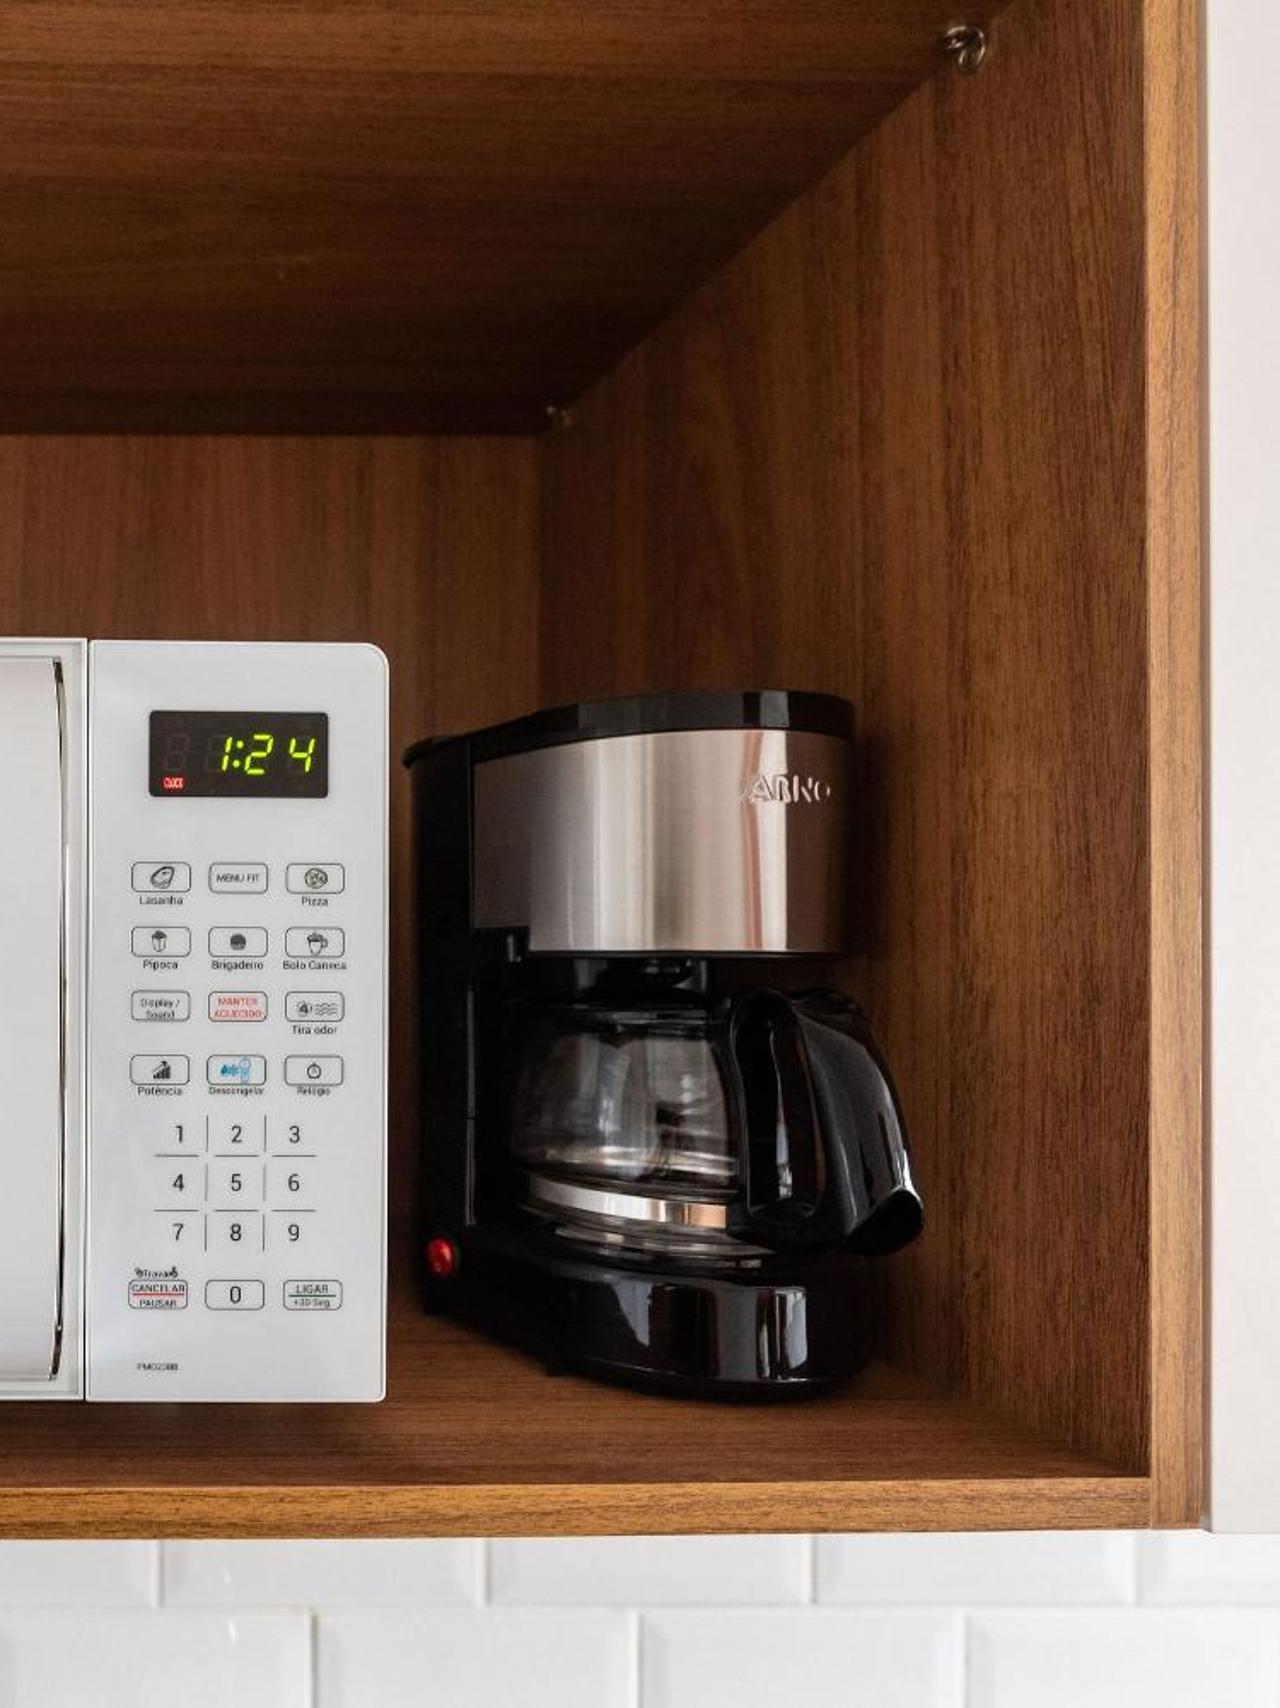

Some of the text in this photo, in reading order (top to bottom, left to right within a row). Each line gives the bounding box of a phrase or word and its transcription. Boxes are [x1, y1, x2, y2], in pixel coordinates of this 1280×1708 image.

[221, 734, 315, 775] 1:24
[216, 873, 259, 882] MENU FIT
[140, 896, 183, 905] Lasanha
[302, 896, 328, 906] Pizza
[143, 960, 178, 970] Pipoca
[211, 960, 263, 972] Brigadeiro
[283, 960, 306, 970] Bolo
[292, 1025, 337, 1035] Tira odor
[176, 1125, 183, 1143] 1
[231, 1125, 242, 1143] 2
[289, 1125, 300, 1143] 3
[172, 1173, 184, 1191] 4
[231, 1173, 242, 1191] 5
[288, 1173, 300, 1191] 6
[172, 1223, 184, 1241] 7
[229, 1223, 242, 1241] 8
[288, 1223, 300, 1241] 9
[132, 1284, 185, 1292] CANCELAR
[230, 1286, 241, 1304] 0
[296, 1284, 328, 1293] LIGAR
[139, 1299, 177, 1307] PAUSAR
